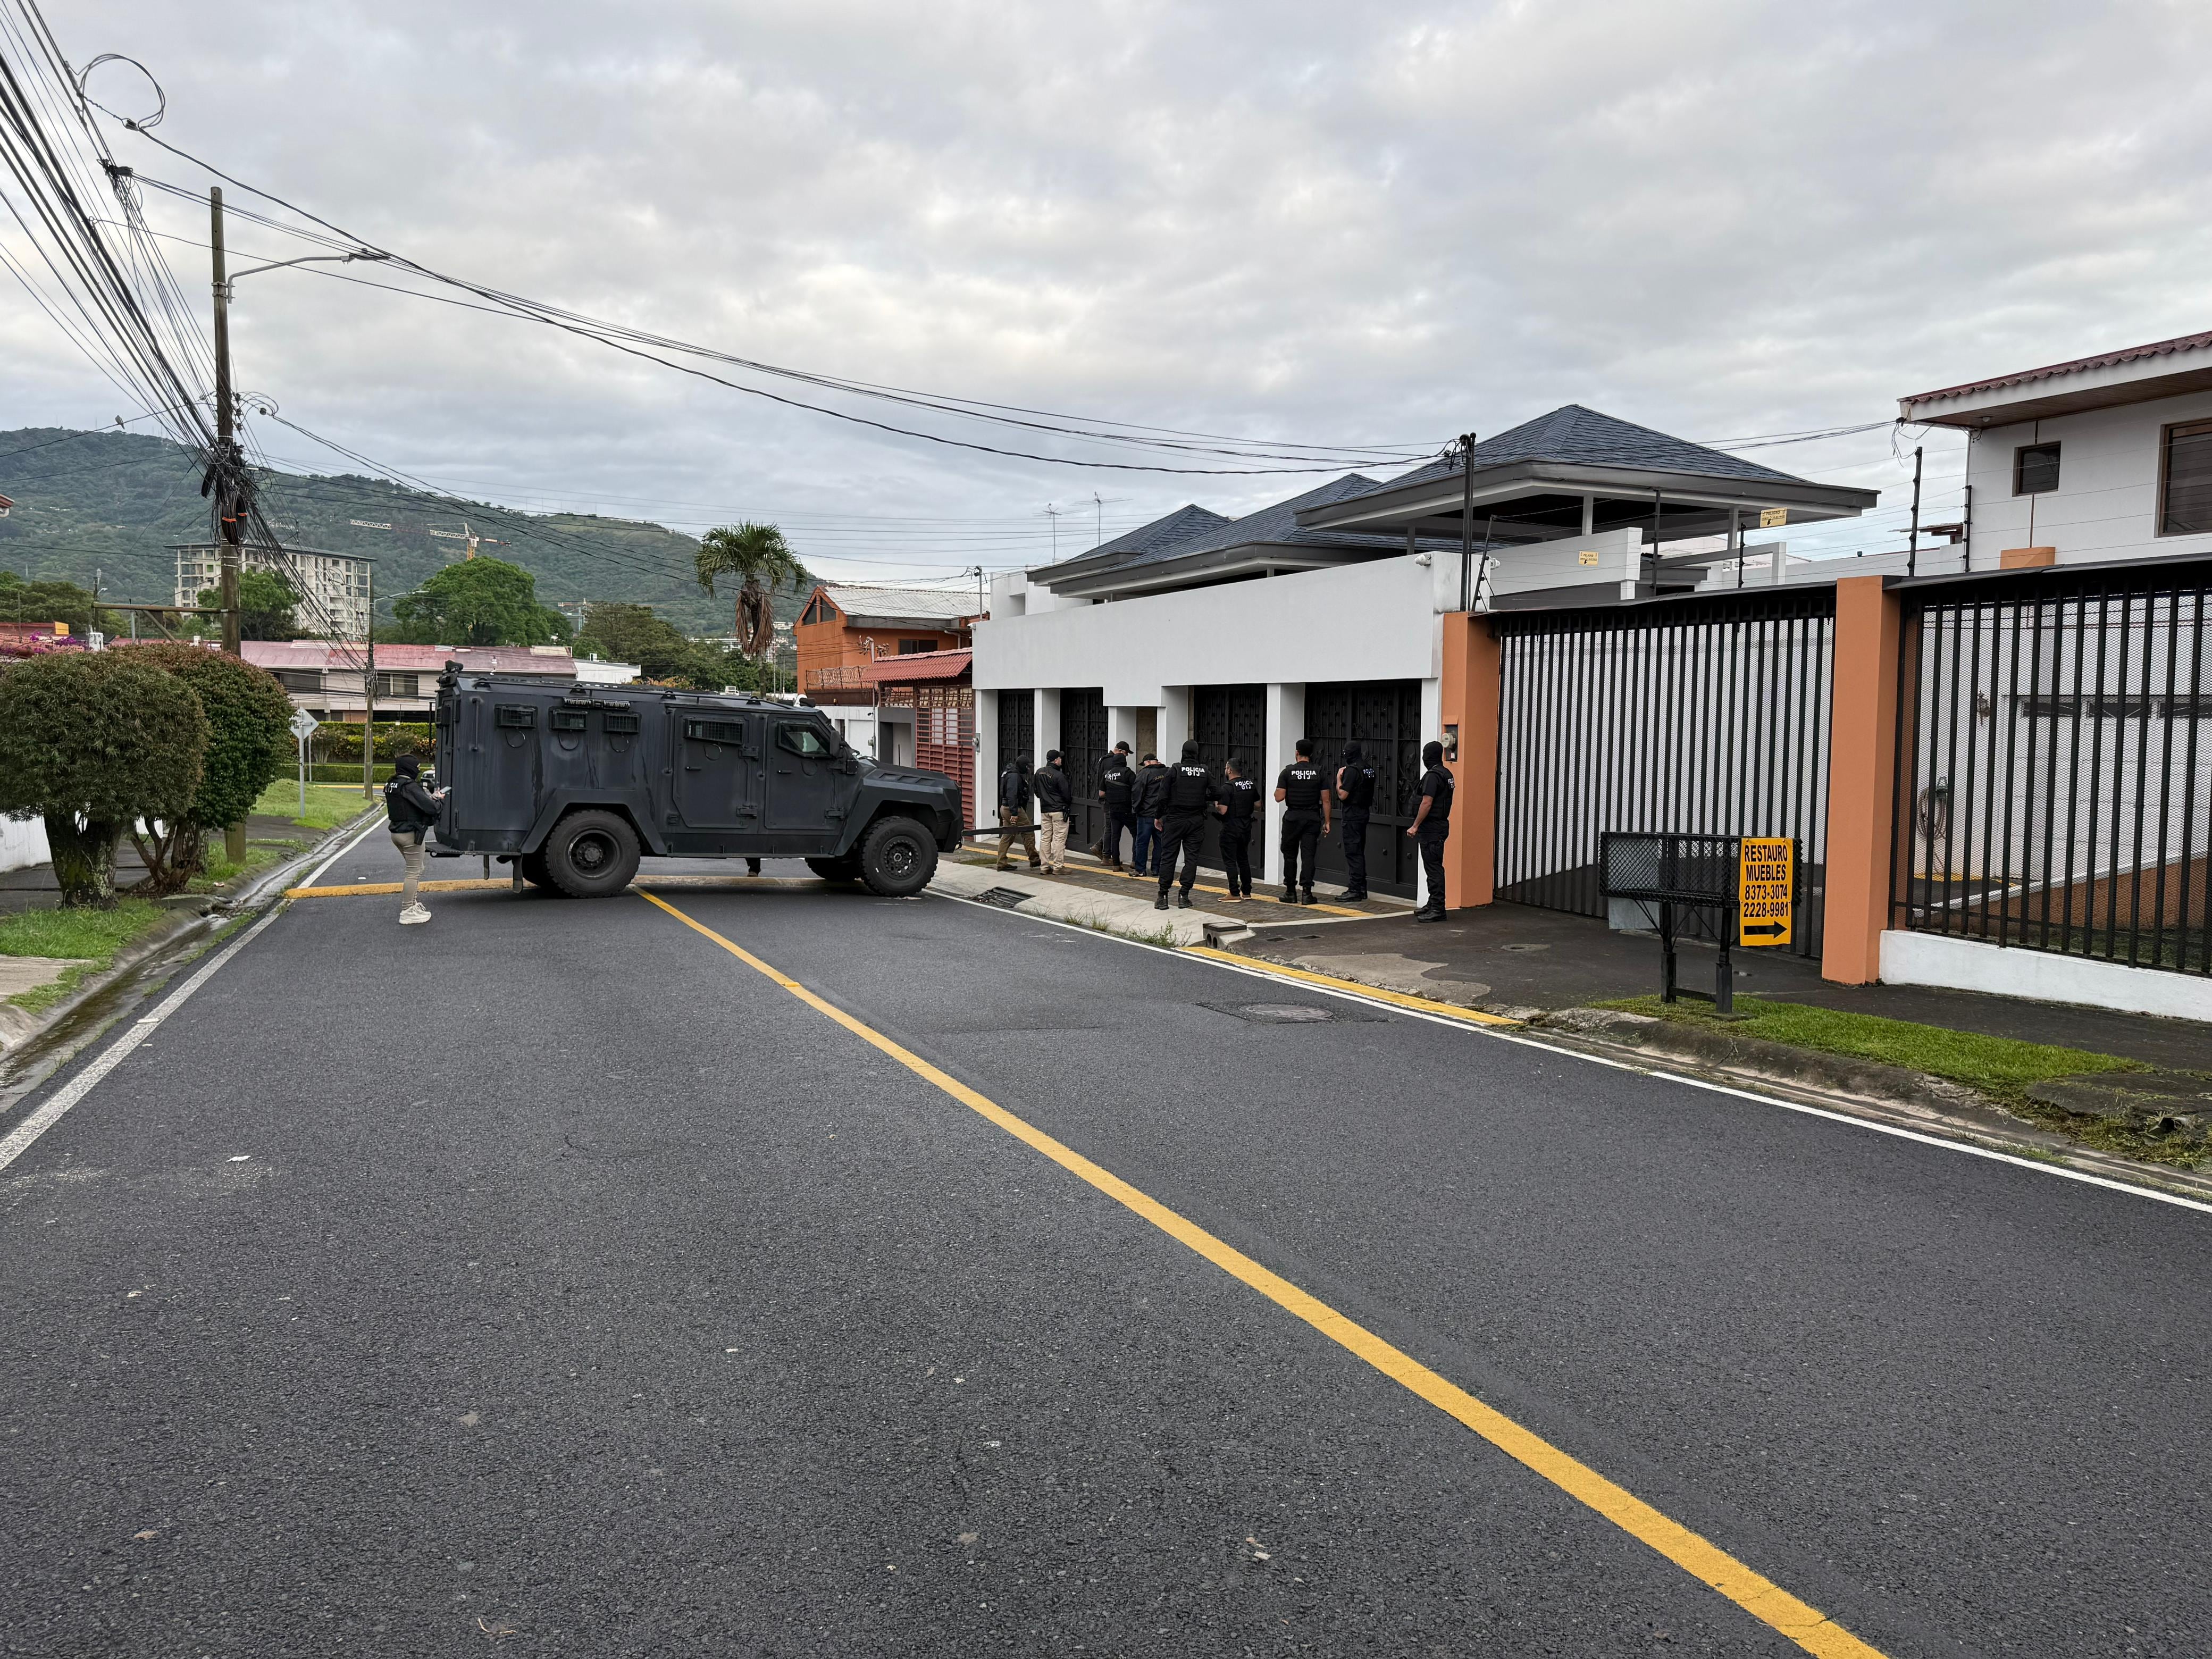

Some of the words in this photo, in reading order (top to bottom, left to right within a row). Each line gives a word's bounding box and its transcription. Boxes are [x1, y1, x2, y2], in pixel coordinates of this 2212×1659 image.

[1745, 845, 1788, 862] RESTAURO
[1746, 864, 1786, 882] MUEBLES
[1745, 884, 1788, 900] 8373-3074
[1744, 902, 1788, 917] 2228-9981
